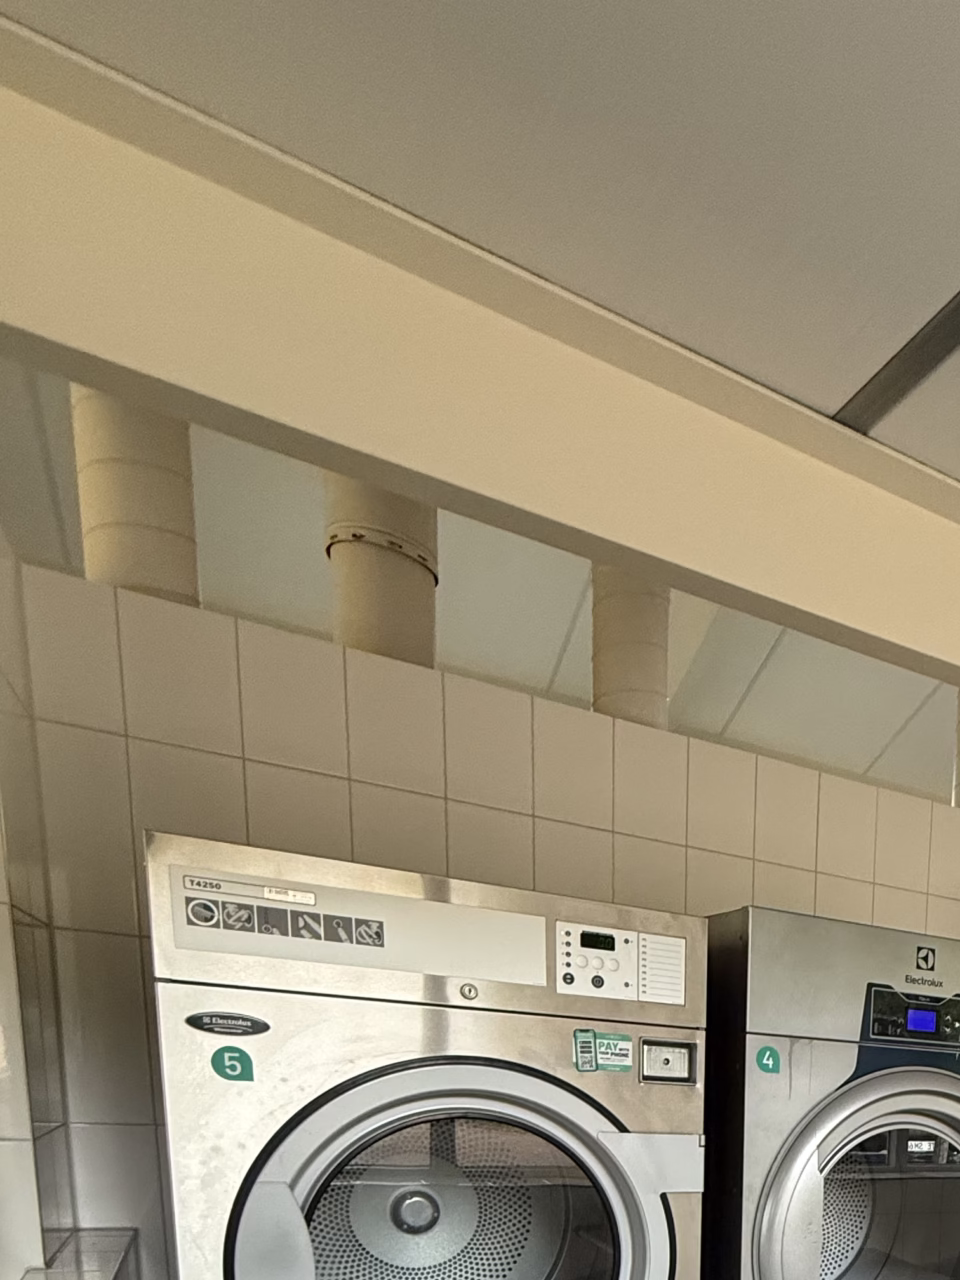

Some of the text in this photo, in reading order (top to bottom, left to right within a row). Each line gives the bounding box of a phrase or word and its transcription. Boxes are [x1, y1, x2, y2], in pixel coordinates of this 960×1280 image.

[189, 879, 222, 890] T4250
[905, 974, 944, 988] Electrolux
[212, 1016, 252, 1027] Electrolux
[598, 1041, 619, 1051] PAY
[223, 1052, 242, 1076] 5
[762, 1050, 774, 1069] 4
